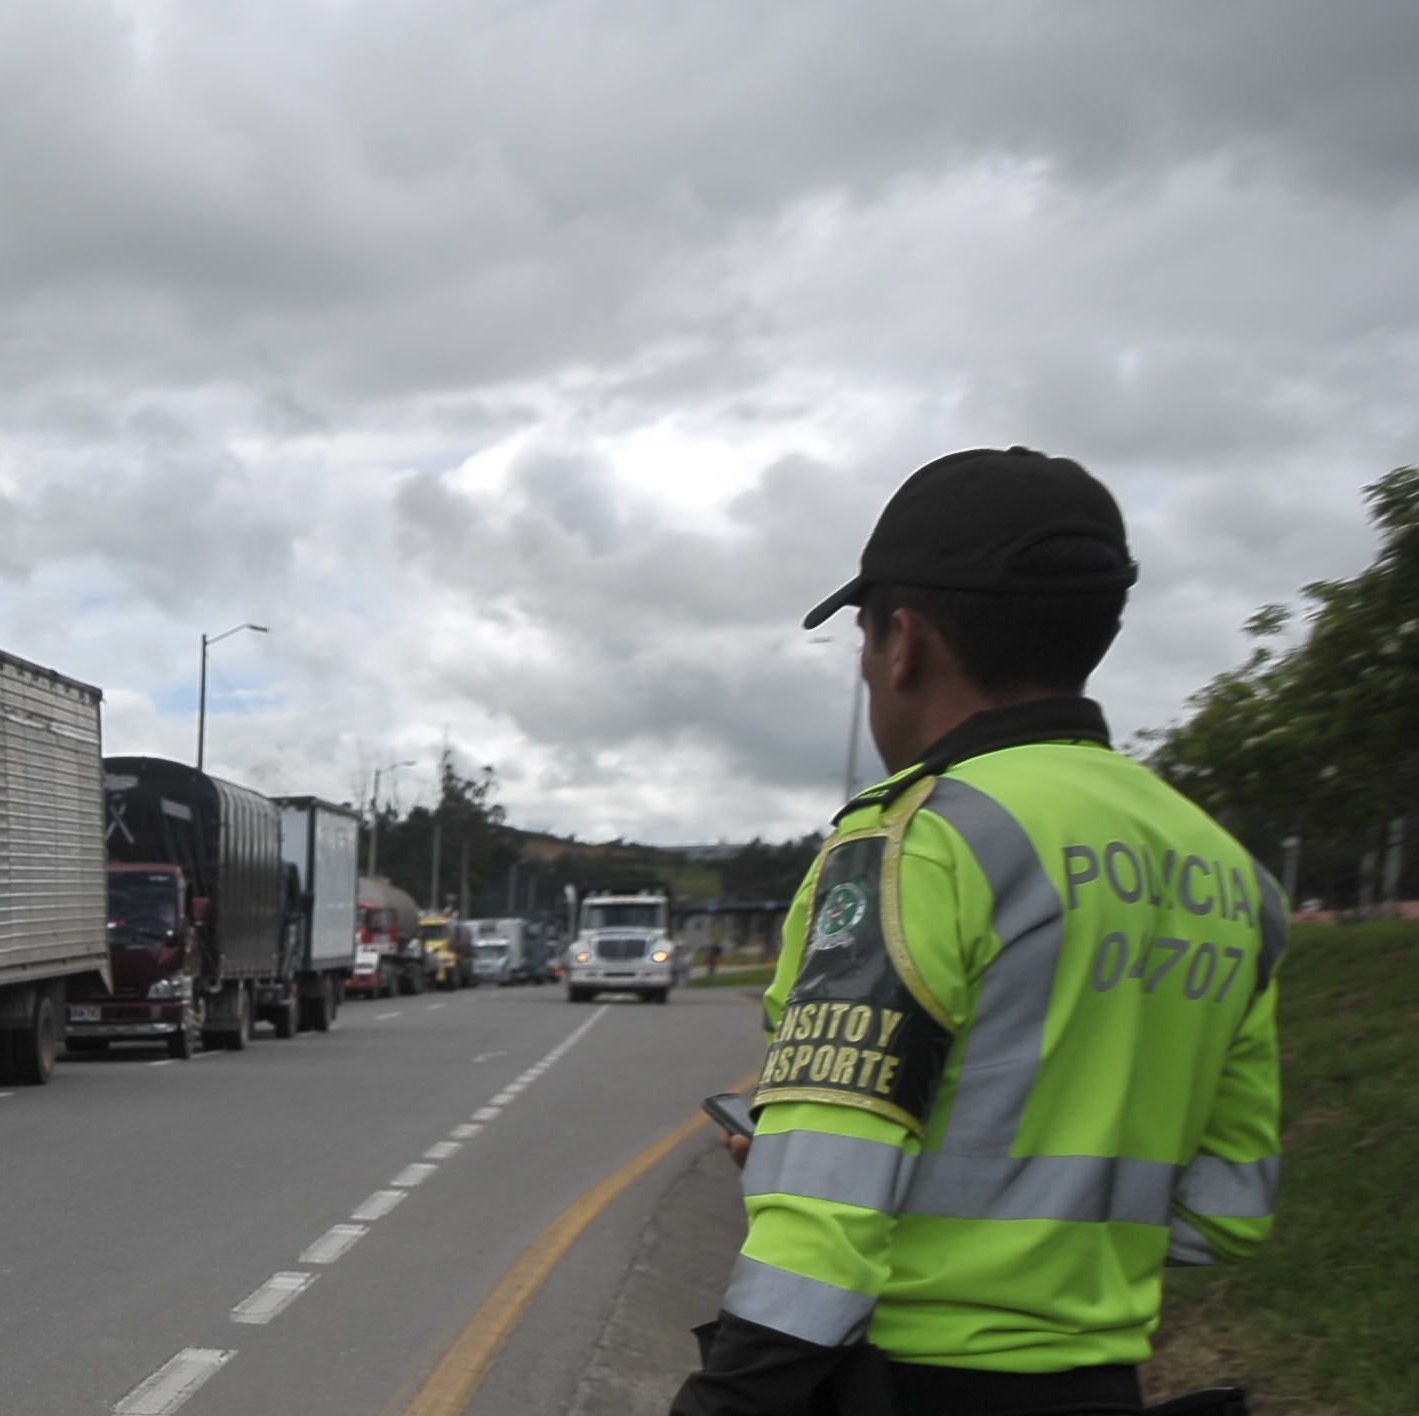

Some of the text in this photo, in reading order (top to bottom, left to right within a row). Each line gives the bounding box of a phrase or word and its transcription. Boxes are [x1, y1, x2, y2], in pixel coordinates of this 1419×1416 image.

[1061, 841, 1257, 928] POLICIA
[1093, 931, 1245, 1003] 04707
[877, 1008, 904, 1048] Y
[760, 1044, 901, 1094] NSPORTE
